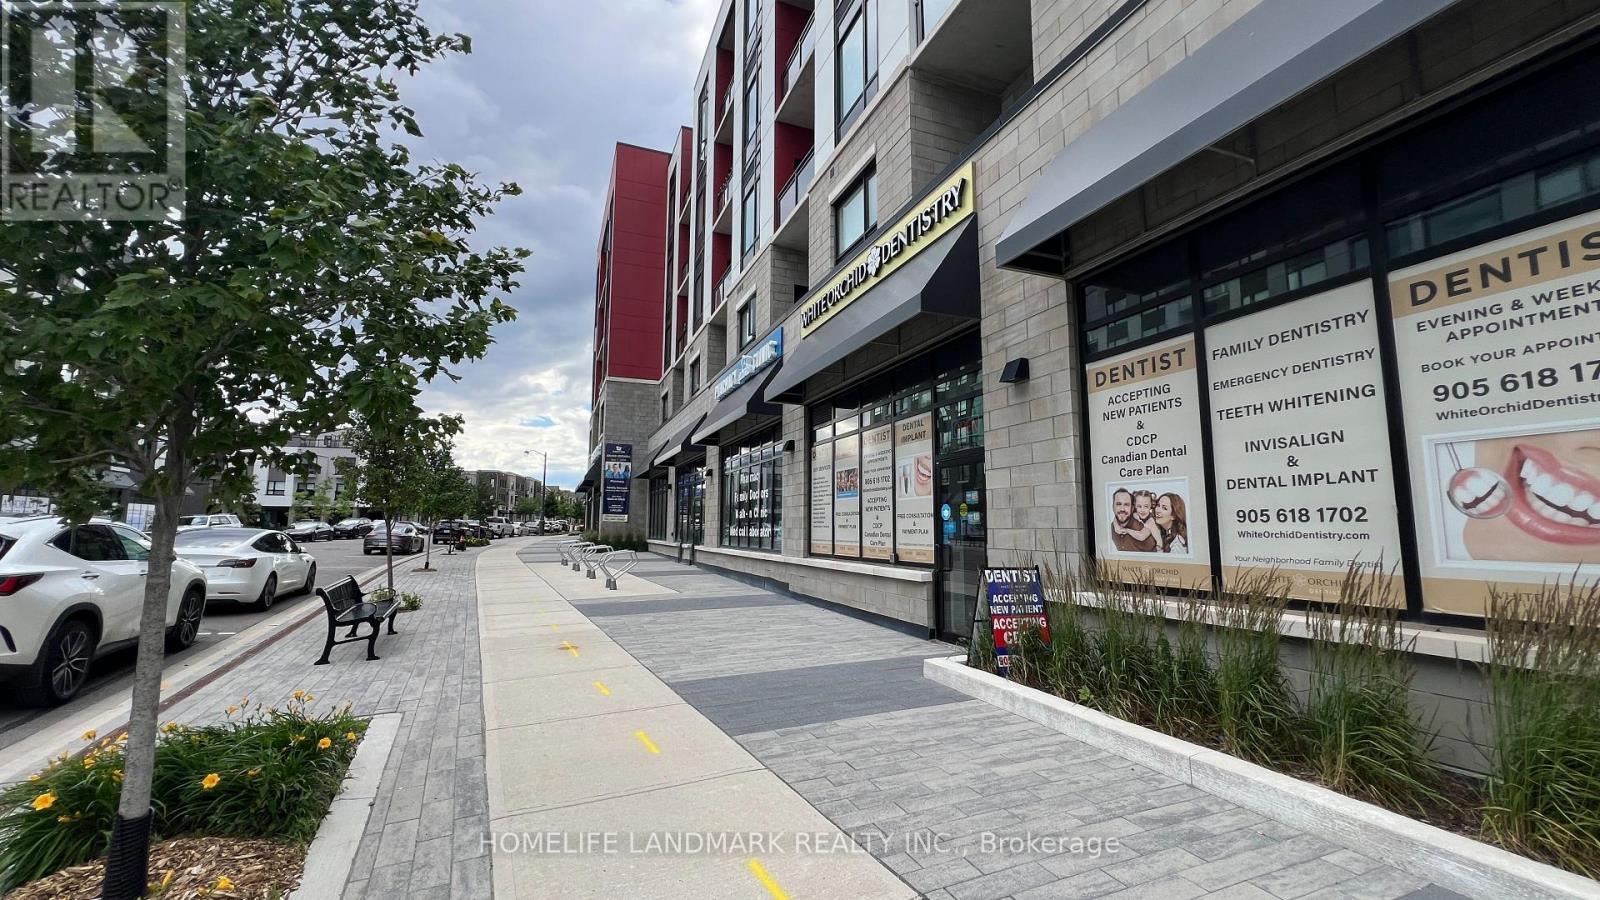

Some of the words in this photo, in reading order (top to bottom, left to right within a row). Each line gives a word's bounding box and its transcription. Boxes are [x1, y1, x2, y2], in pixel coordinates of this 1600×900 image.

[881, 178, 967, 265] DENTISTRY
[1409, 230, 1600, 307] DENTIS
[1416, 303, 1503, 332] EVENING
[1511, 299, 1524, 311] &
[1531, 279, 1600, 305] WEEK
[1446, 299, 1600, 343] APPOINTMENT
[1211, 337, 1264, 361] FAMILY
[1268, 309, 1369, 347] DENTISTRY
[1095, 348, 1187, 388] DENTIST
[1213, 366, 1289, 391] EMERGENCY
[1292, 347, 1376, 375] DENTISTRY
[1421, 357, 1465, 373] BOOK
[1470, 348, 1516, 364] YOUR
[1432, 377, 1490, 403] 905
[1500, 367, 1559, 393] 618
[1569, 360, 1600, 383] 17
[1107, 383, 1171, 406] ACCEPTING
[1216, 403, 1264, 421] TEETH
[1268, 383, 1376, 413] WHITENING
[1102, 407, 1126, 422] NEW
[1128, 397, 1183, 417] PATIENTS
[902, 419, 924, 432] DENTAL
[1136, 420, 1145, 430] &
[864, 430, 891, 445] DENTIST
[1126, 433, 1158, 447] CDCP
[1244, 429, 1345, 453] INVISALIGN
[1101, 449, 1148, 465] Canadian
[1150, 445, 1188, 460] Dental
[1286, 455, 1299, 468] &
[1119, 466, 1144, 478] Care
[1145, 465, 1170, 476] Plan
[1226, 475, 1288, 490] DENTAL
[1291, 468, 1379, 487] IMPLANT
[750, 488, 769, 501] Docors
[1236, 508, 1271, 524] 905
[1276, 507, 1311, 524] 618
[1316, 506, 1369, 523] 1702
[729, 525, 746, 537] Medcal
[1237, 530, 1370, 542] WhiteOrchidDentistry.com
[1252, 555, 1311, 566] Neighborhood
[1313, 557, 1345, 567] Family
[984, 569, 1037, 583] DENTIST
[1307, 577, 1346, 588] ORCHI
[992, 593, 1038, 604] ACCEPG
[989, 605, 1009, 615] NEW
